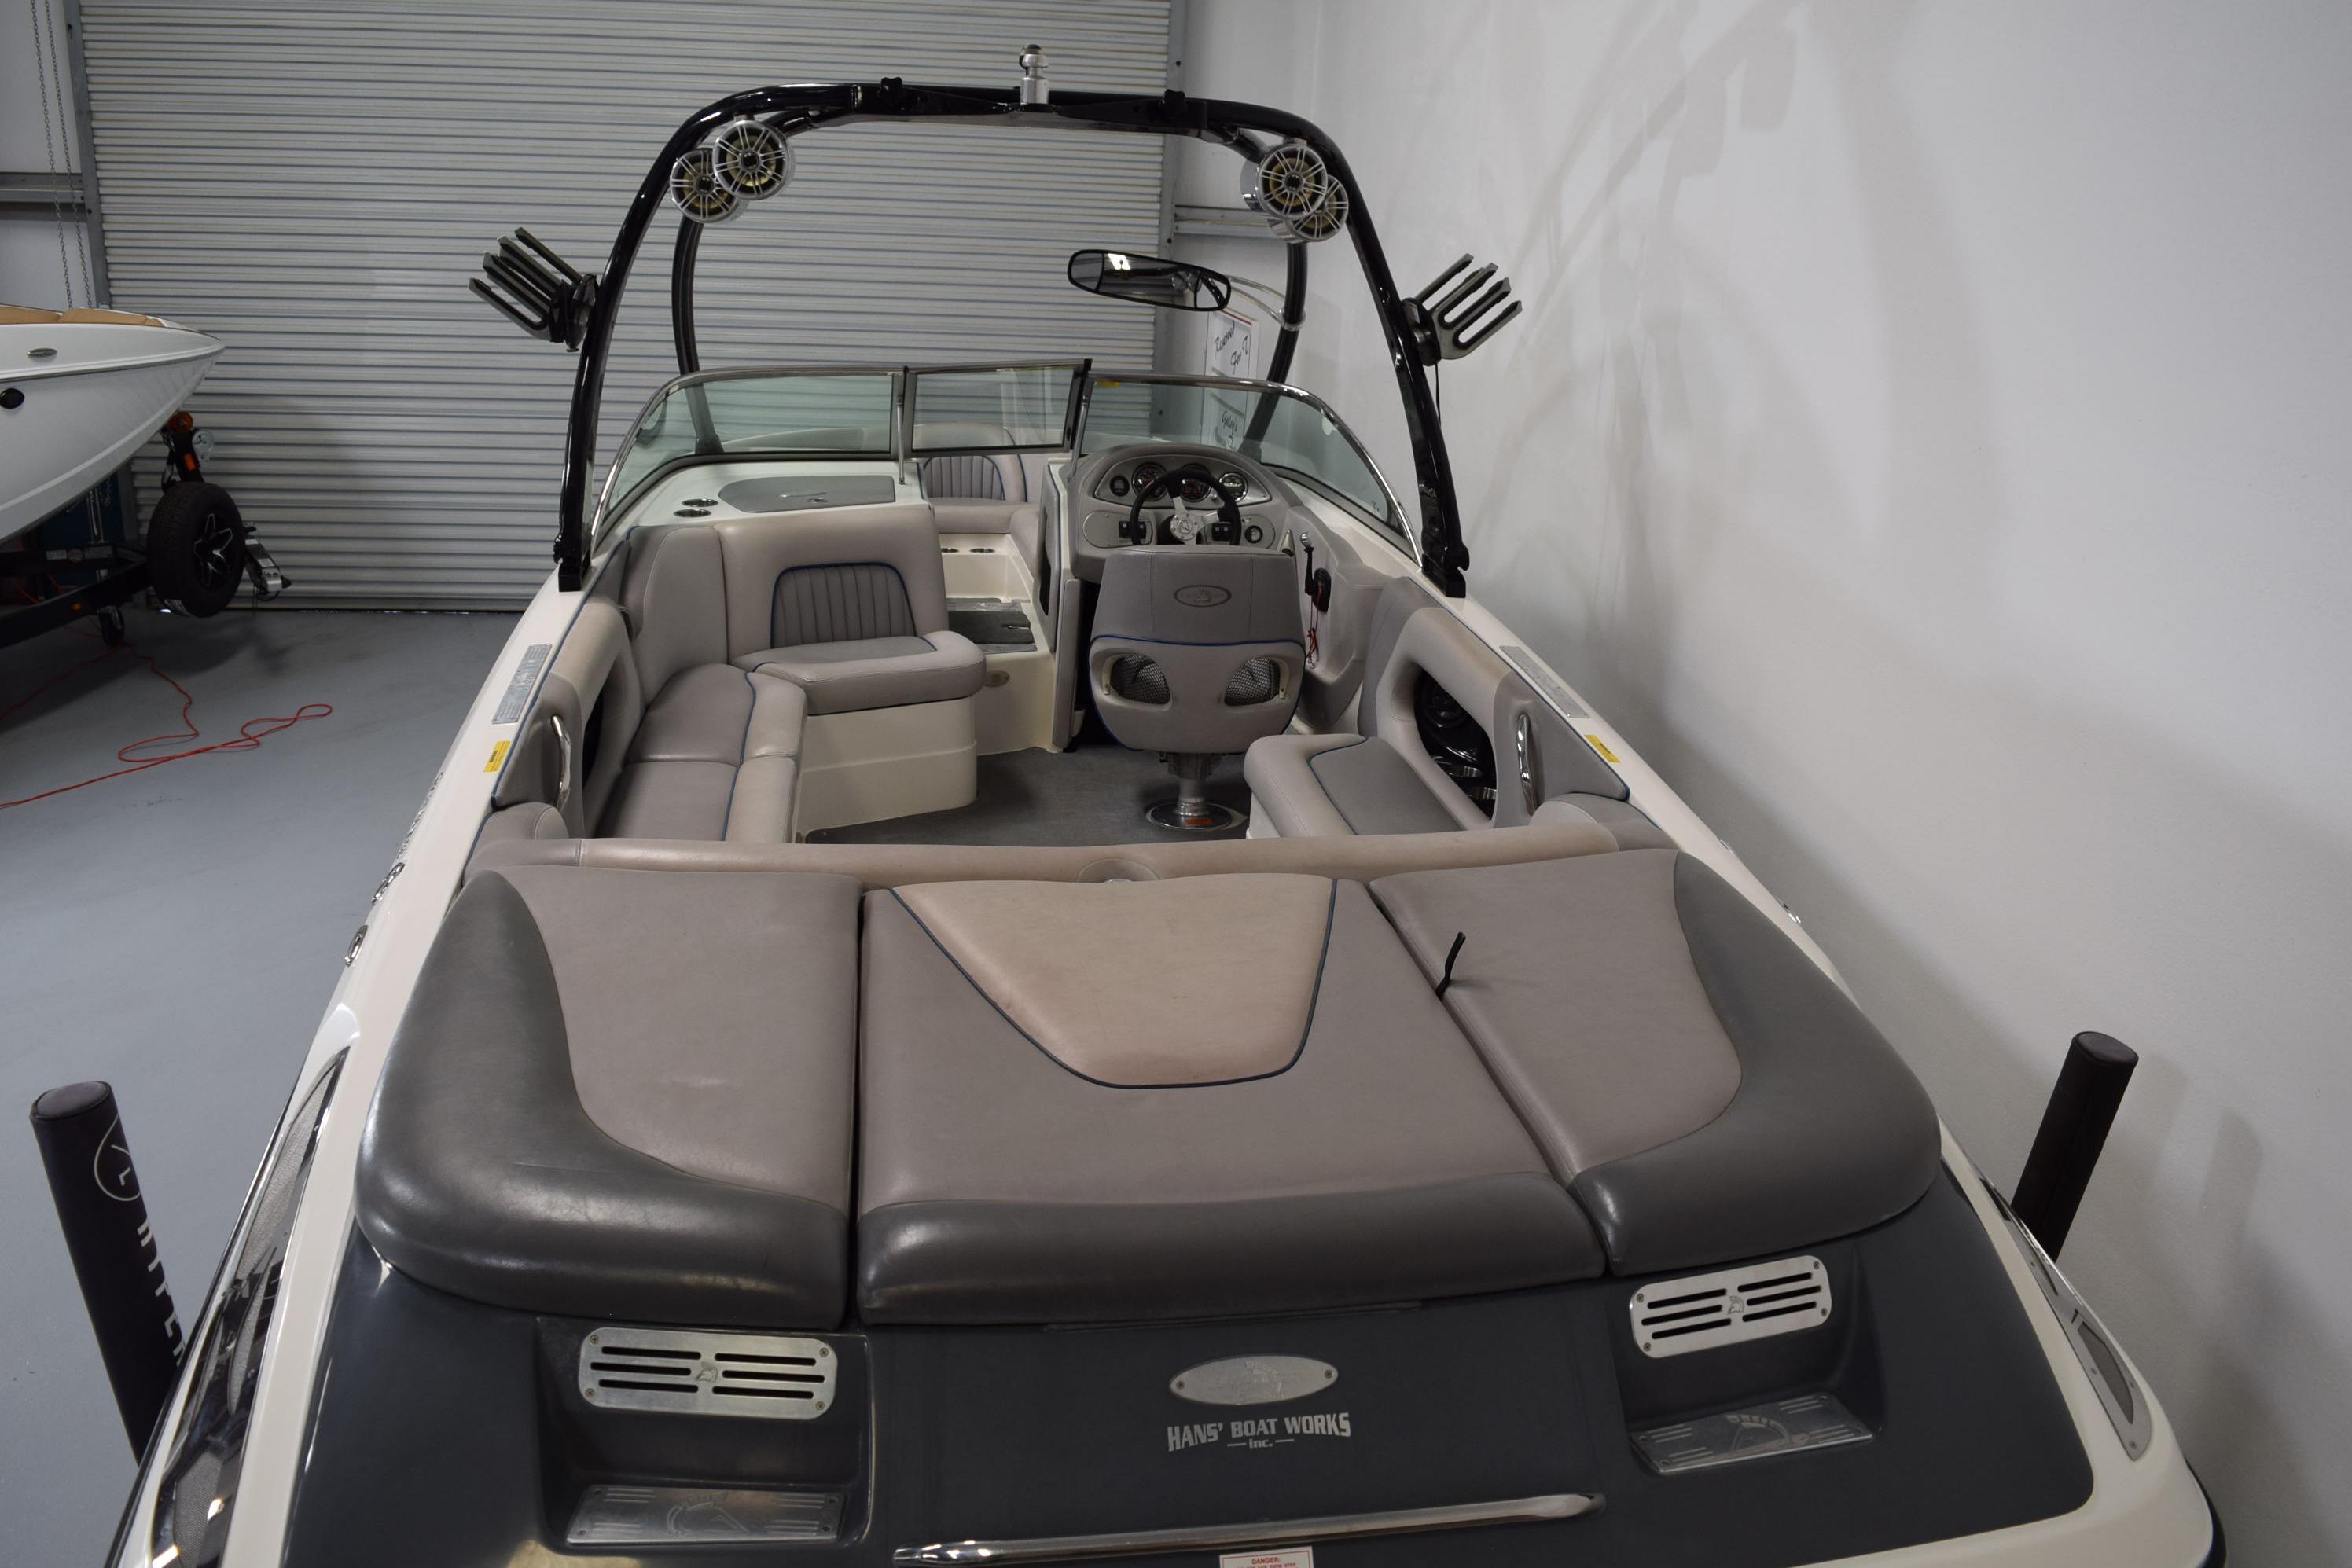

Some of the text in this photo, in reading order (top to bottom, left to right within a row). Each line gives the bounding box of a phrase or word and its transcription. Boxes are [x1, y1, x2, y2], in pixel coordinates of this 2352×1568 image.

[1167, 1412, 1351, 1452] HANS' BOAT WORKS
[1249, 1438, 1273, 1449] inc.
